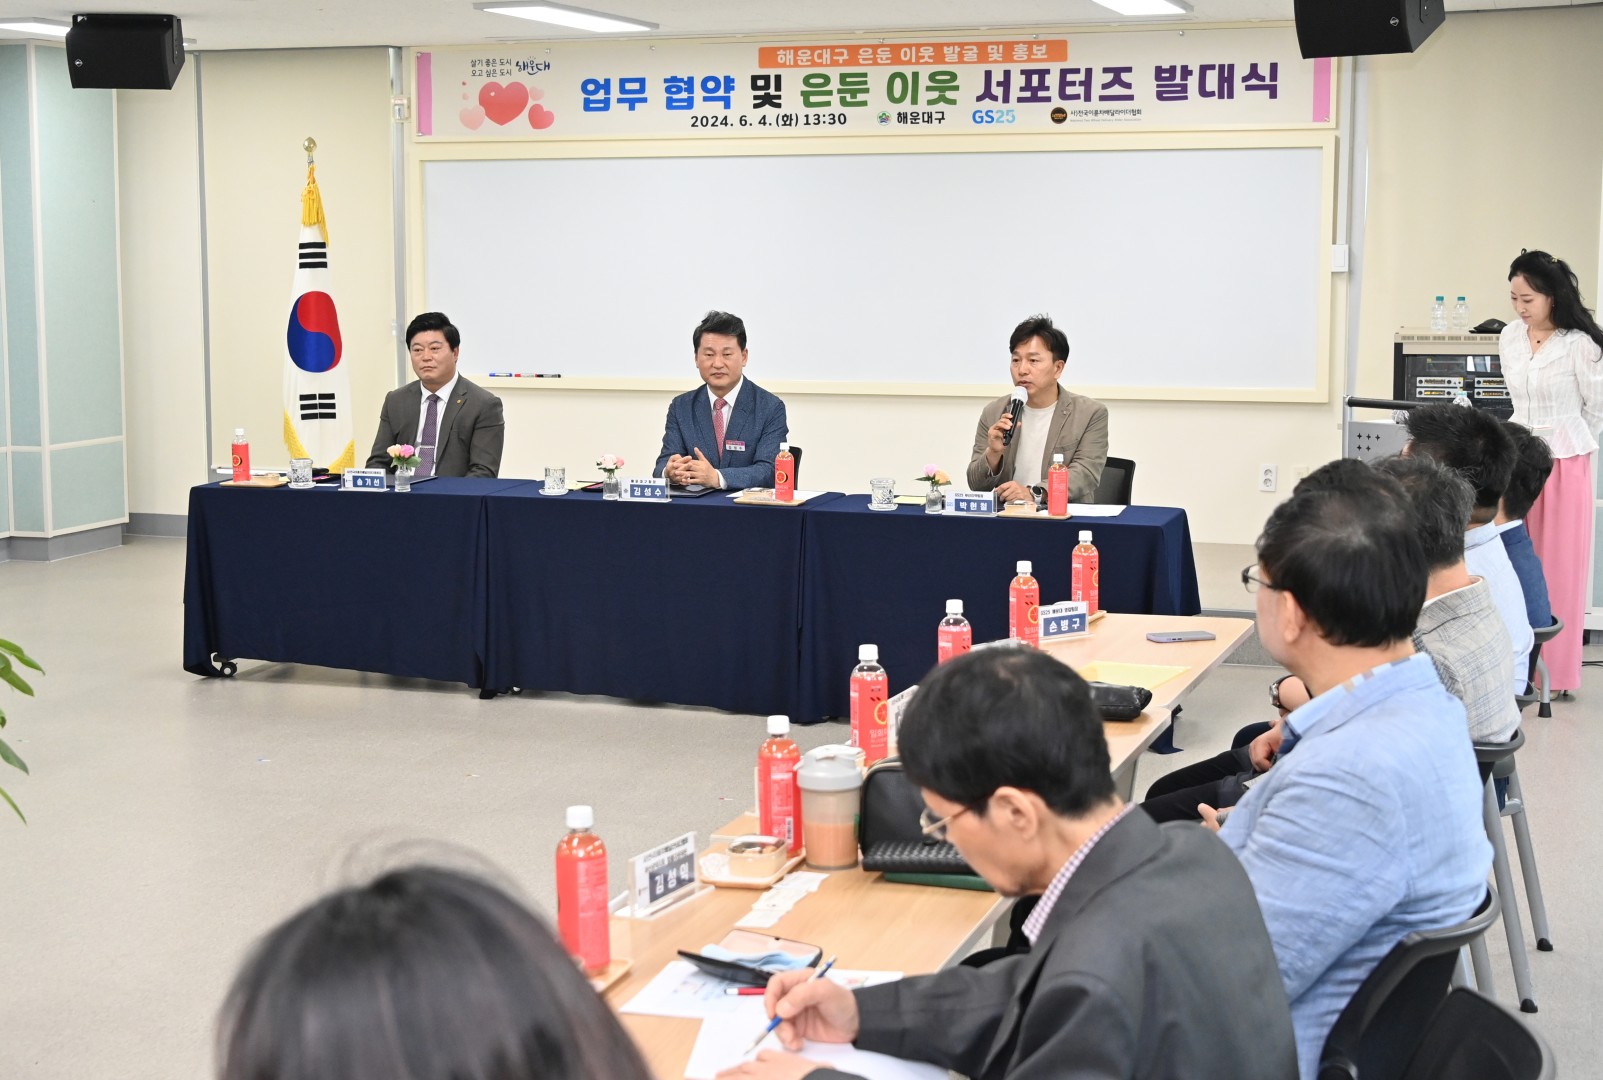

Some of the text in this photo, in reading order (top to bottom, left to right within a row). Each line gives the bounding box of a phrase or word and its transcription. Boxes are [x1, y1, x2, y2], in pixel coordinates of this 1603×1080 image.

[777, 43, 1048, 66] 해운대구 은둔 이웃 발굴 및 홍보
[470, 58, 512, 67] 살기 좋은 도시
[516, 59, 551, 73] 해운대
[471, 69, 484, 77] 오고
[485, 69, 497, 77] 싶은
[580, 62, 1278, 112] 업무 협약 및 은둔 이웃 서포터즈 발대식
[690, 115, 734, 127] 2024.
[803, 113, 847, 125] 13:30
[897, 111, 946, 124] 해운대구
[972, 109, 1016, 124] GS25
[633, 487, 662, 497] 김성수
[1049, 618, 1080, 633] 손병구
